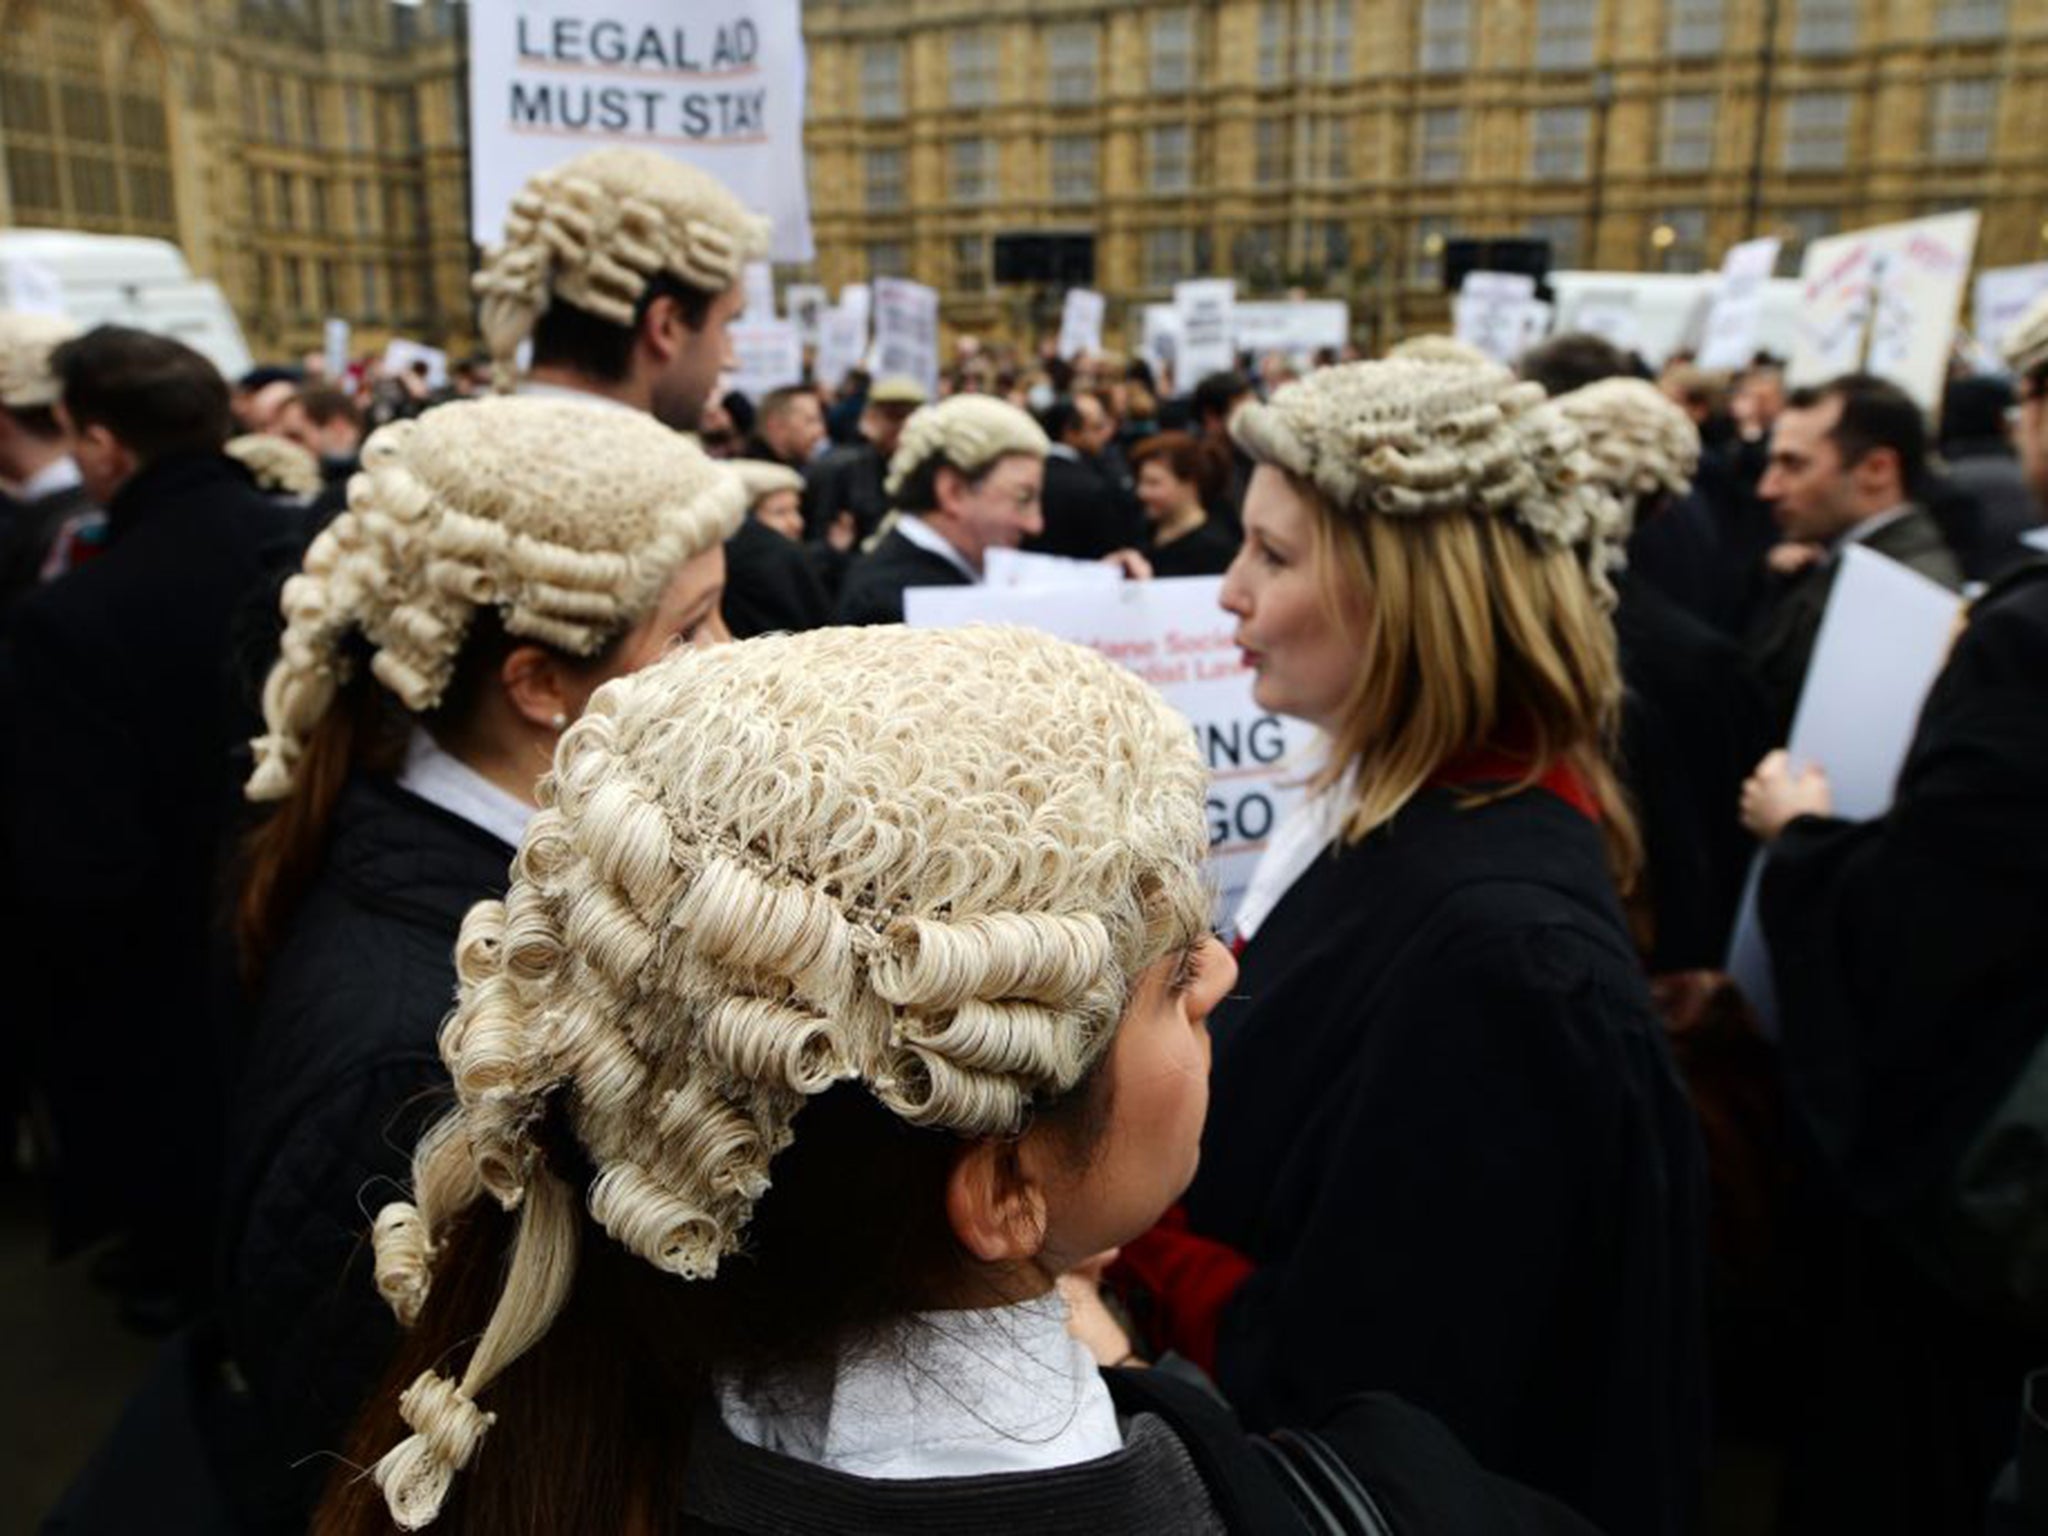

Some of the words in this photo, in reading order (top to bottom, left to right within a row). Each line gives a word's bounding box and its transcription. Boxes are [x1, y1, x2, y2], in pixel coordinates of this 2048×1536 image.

[517, 16, 700, 71] LEGAL
[509, 82, 664, 132] MUST
[681, 88, 767, 138] STAY
[1205, 793, 1274, 847] GO
